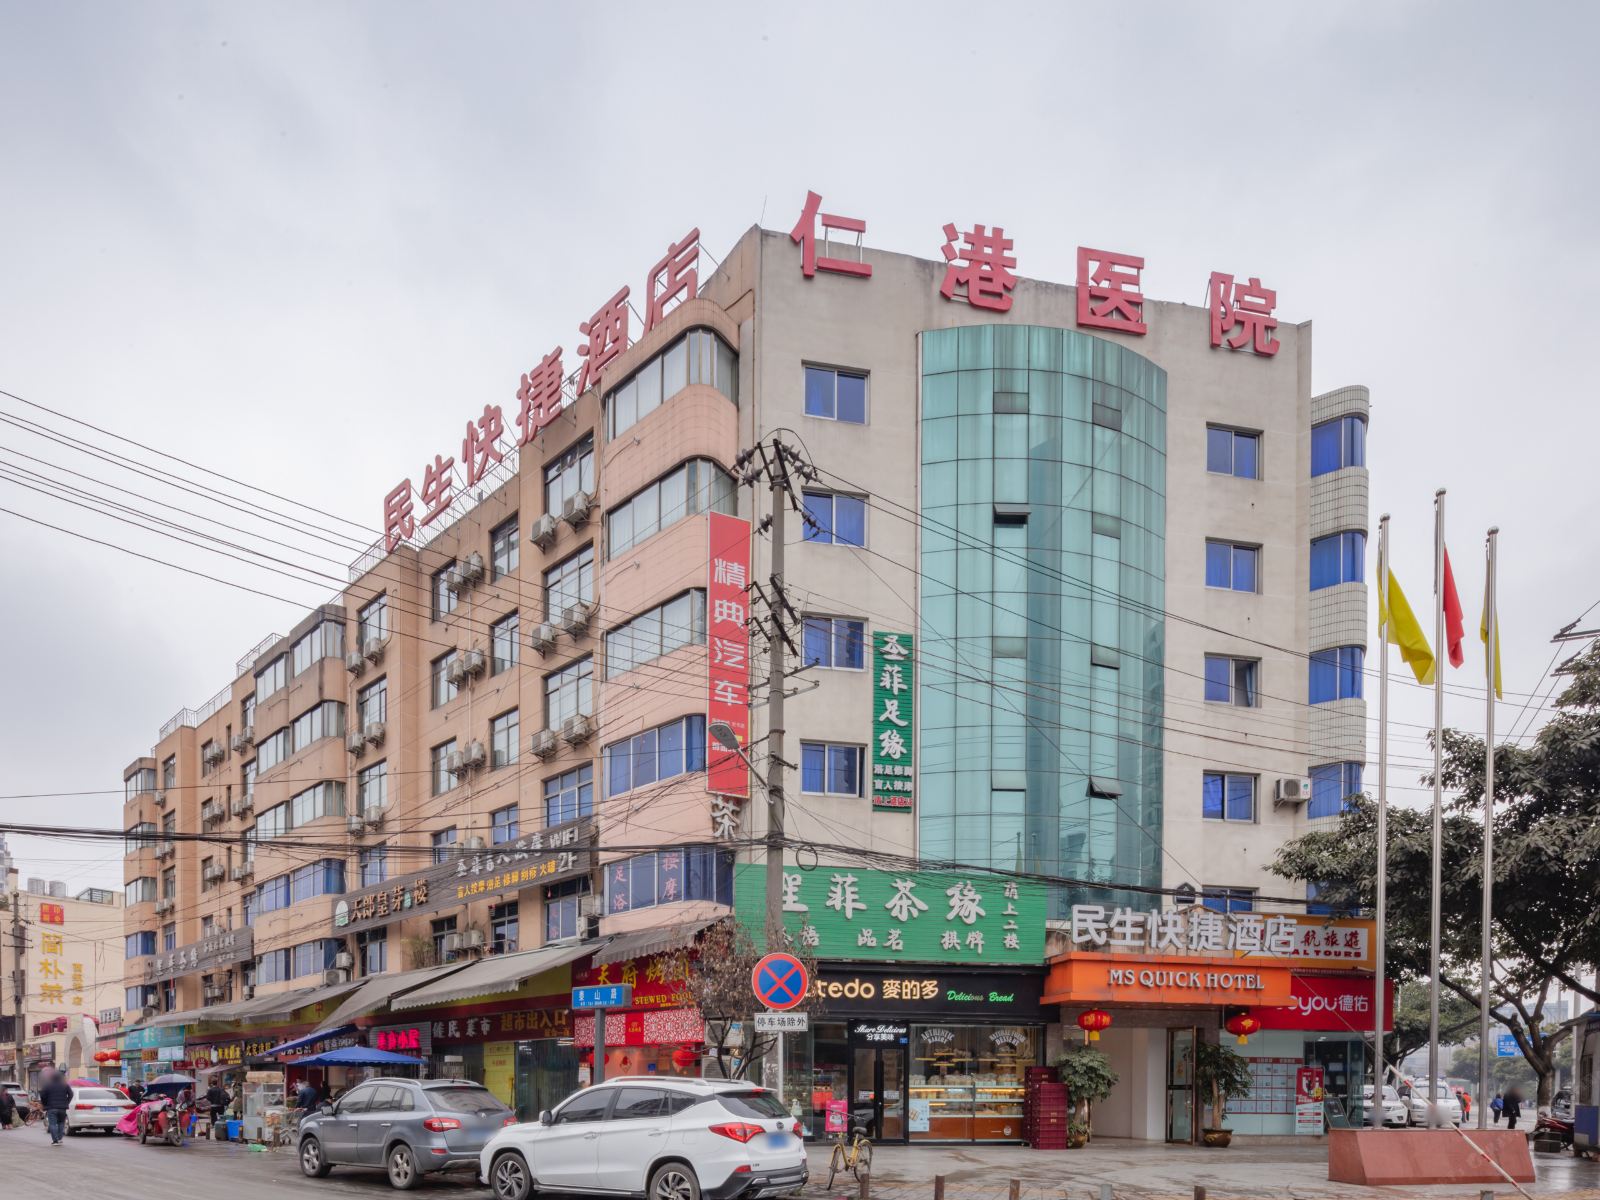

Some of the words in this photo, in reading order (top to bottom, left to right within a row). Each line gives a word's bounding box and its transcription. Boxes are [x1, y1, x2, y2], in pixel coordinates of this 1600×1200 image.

[790, 190, 1280, 358] 仁港医院
[384, 227, 700, 554] 民生快捷酒店
[713, 558, 746, 707] 精典汽车
[550, 826, 579, 849] WIFI
[1071, 904, 1298, 952] 民生快捷酒店
[940, 930, 985, 954] 棋牌
[1314, 950, 1362, 958] TOURS
[1108, 969, 1136, 985] MS
[1138, 970, 1201, 988] QUICK
[1205, 973, 1265, 990] HOTEL
[634, 994, 668, 1005] STEWED
[946, 989, 985, 1001] Delicious
[988, 991, 1015, 1003] Bread
[1338, 994, 1369, 1012] 德佑
[757, 1017, 806, 1027] 停车场除外
